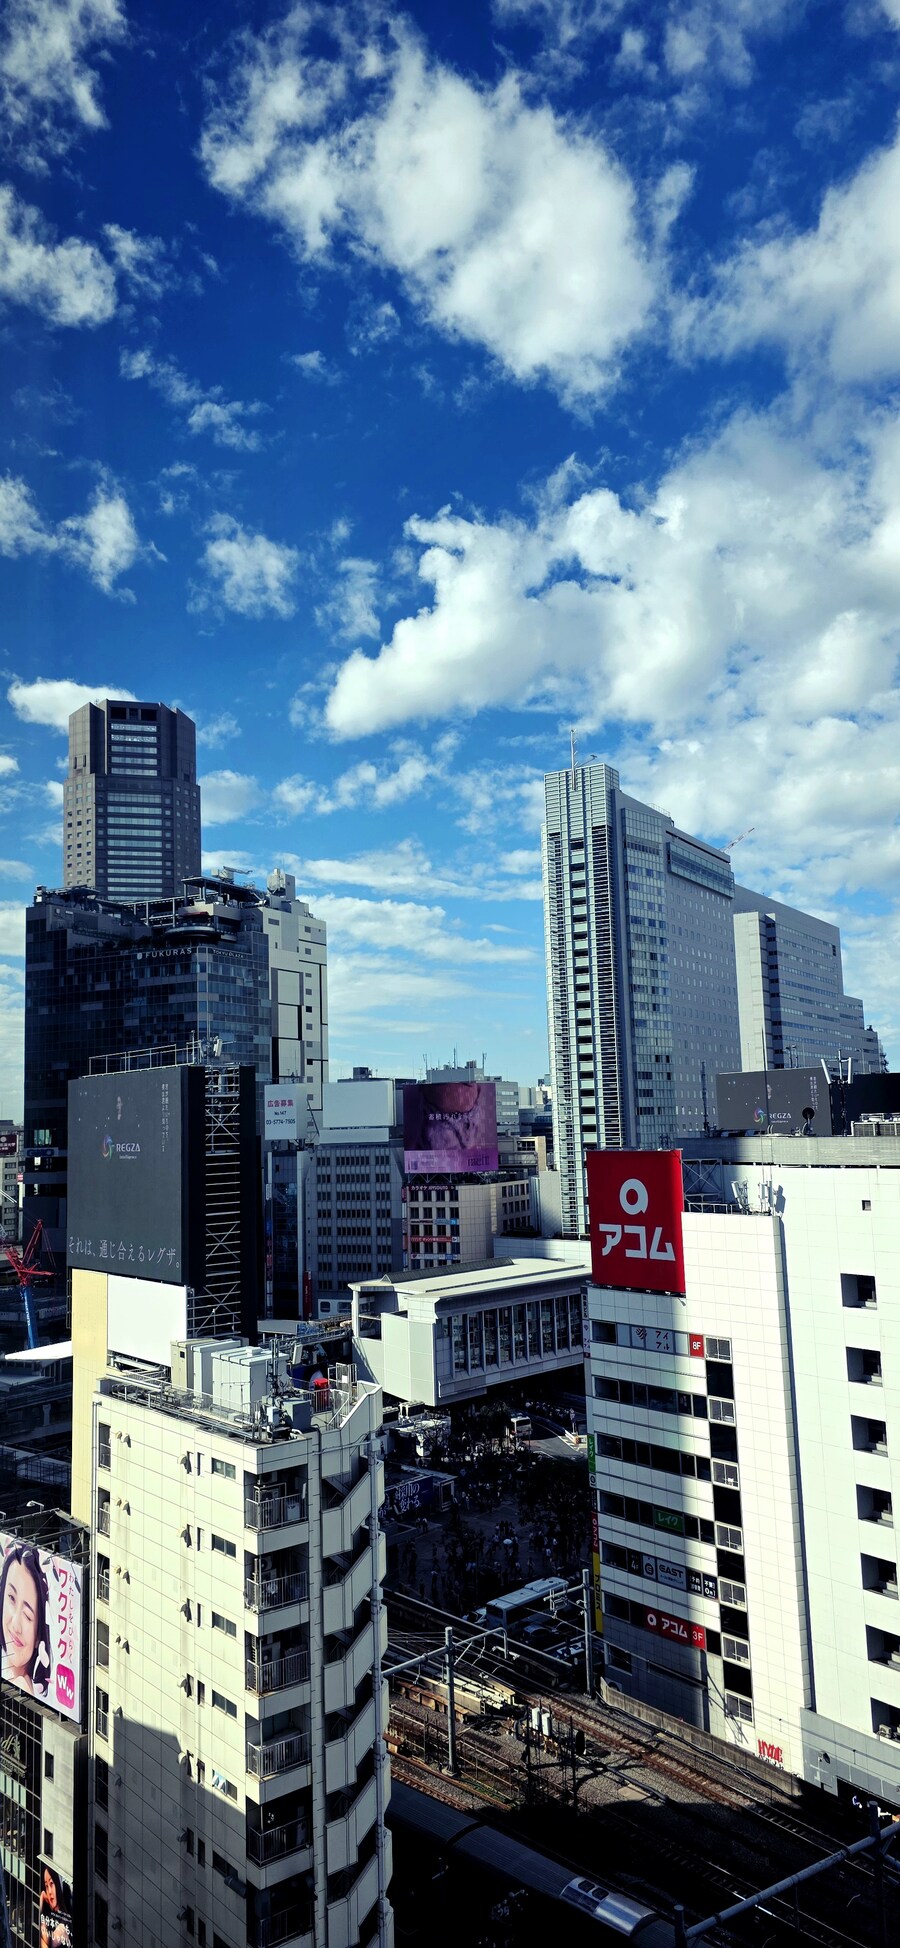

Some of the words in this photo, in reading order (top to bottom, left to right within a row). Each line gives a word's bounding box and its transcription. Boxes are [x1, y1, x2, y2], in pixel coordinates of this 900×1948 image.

[145, 947, 192, 959] FUKURAS
[267, 1099, 294, 1108] 広告募集
[116, 1143, 141, 1152] REGZA
[598, 1223, 676, 1261] アコム
[69, 1236, 180, 1269] それは、通じ合えるレグザ。
[655, 1331, 669, 1340] アイ
[692, 1341, 701, 1351] 8F
[657, 1512, 679, 1527] レイク
[659, 1564, 684, 1578] EAST
[594, 1574, 602, 1611] プロミス
[58, 1568, 68, 1659] ワクワク
[661, 1617, 688, 1639] アコム
[692, 1630, 704, 1642] 3F
